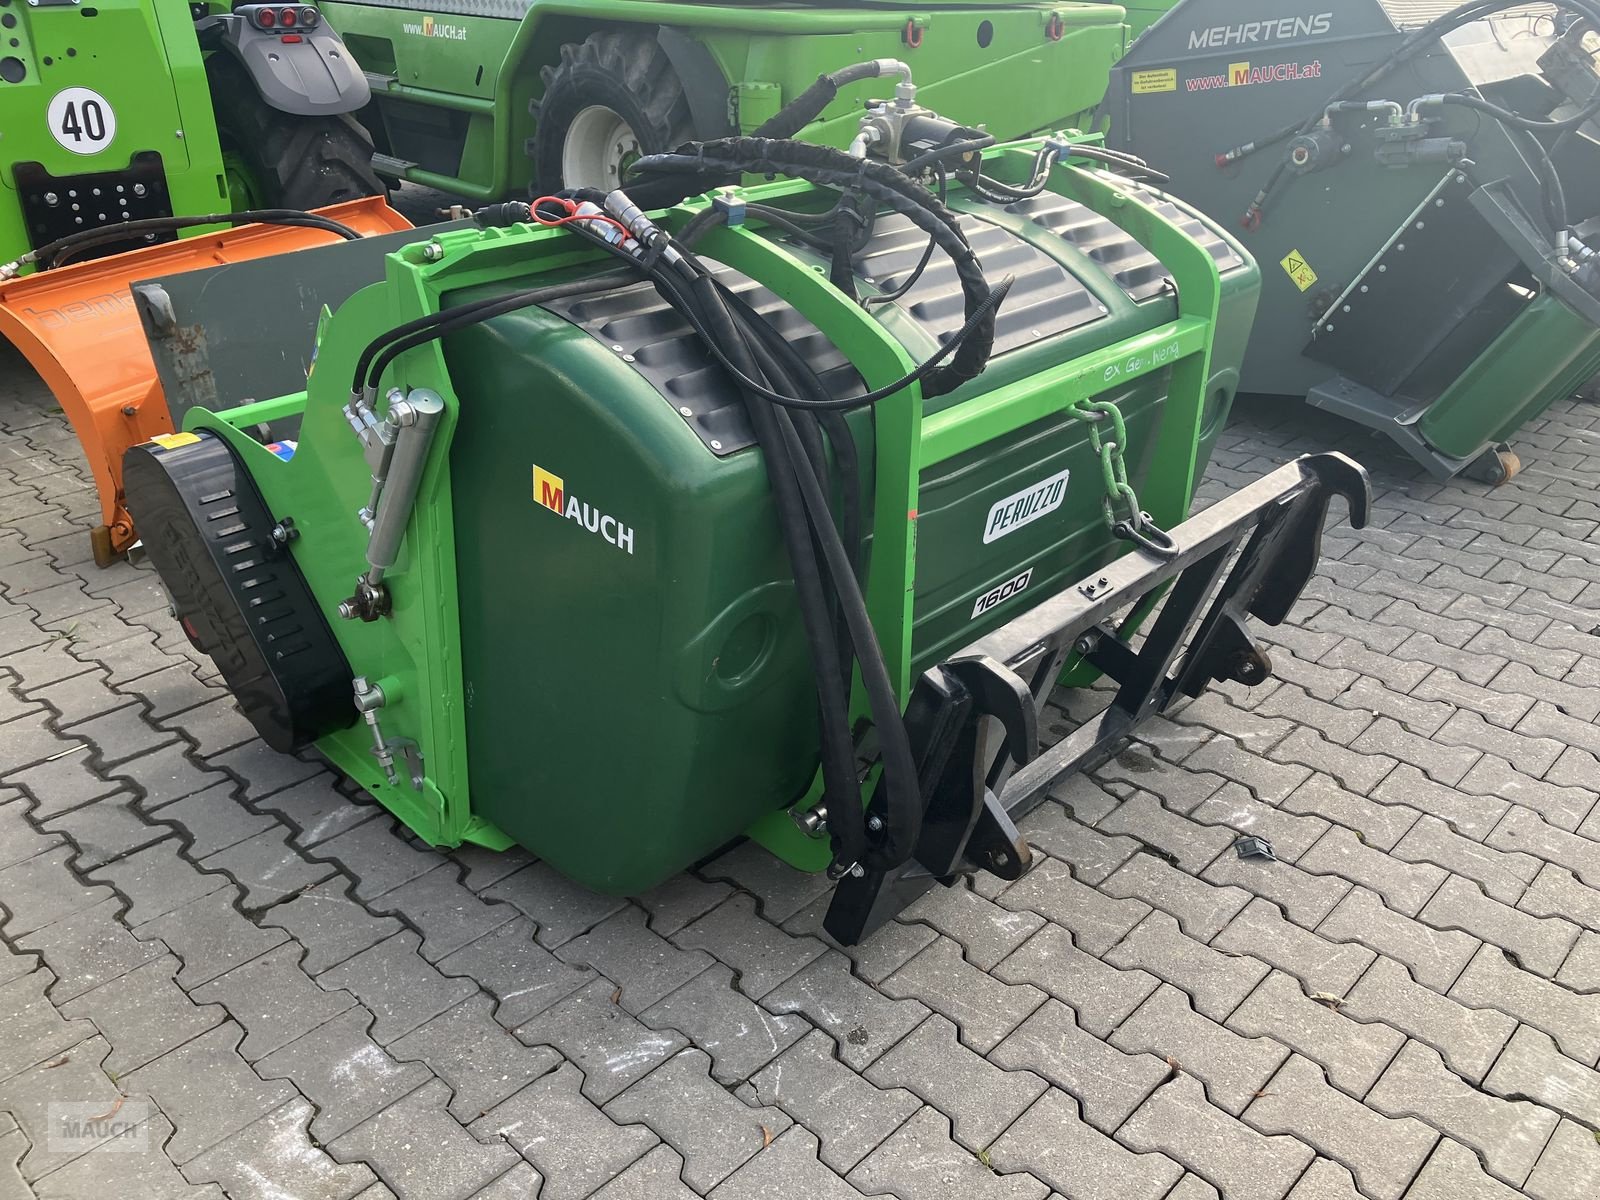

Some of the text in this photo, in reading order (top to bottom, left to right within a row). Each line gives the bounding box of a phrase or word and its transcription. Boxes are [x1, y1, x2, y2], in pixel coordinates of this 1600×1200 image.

[403, 23, 467, 41] www.MAUCH.at
[1188, 12, 1333, 49] MEHRTENS
[1186, 60, 1322, 91] www.MAUCH.at
[62, 100, 106, 142] 40
[1104, 363, 1120, 382] ex
[542, 479, 634, 556] MAUCH
[988, 478, 1066, 536] PERUZZO
[977, 572, 1030, 613] 1600
